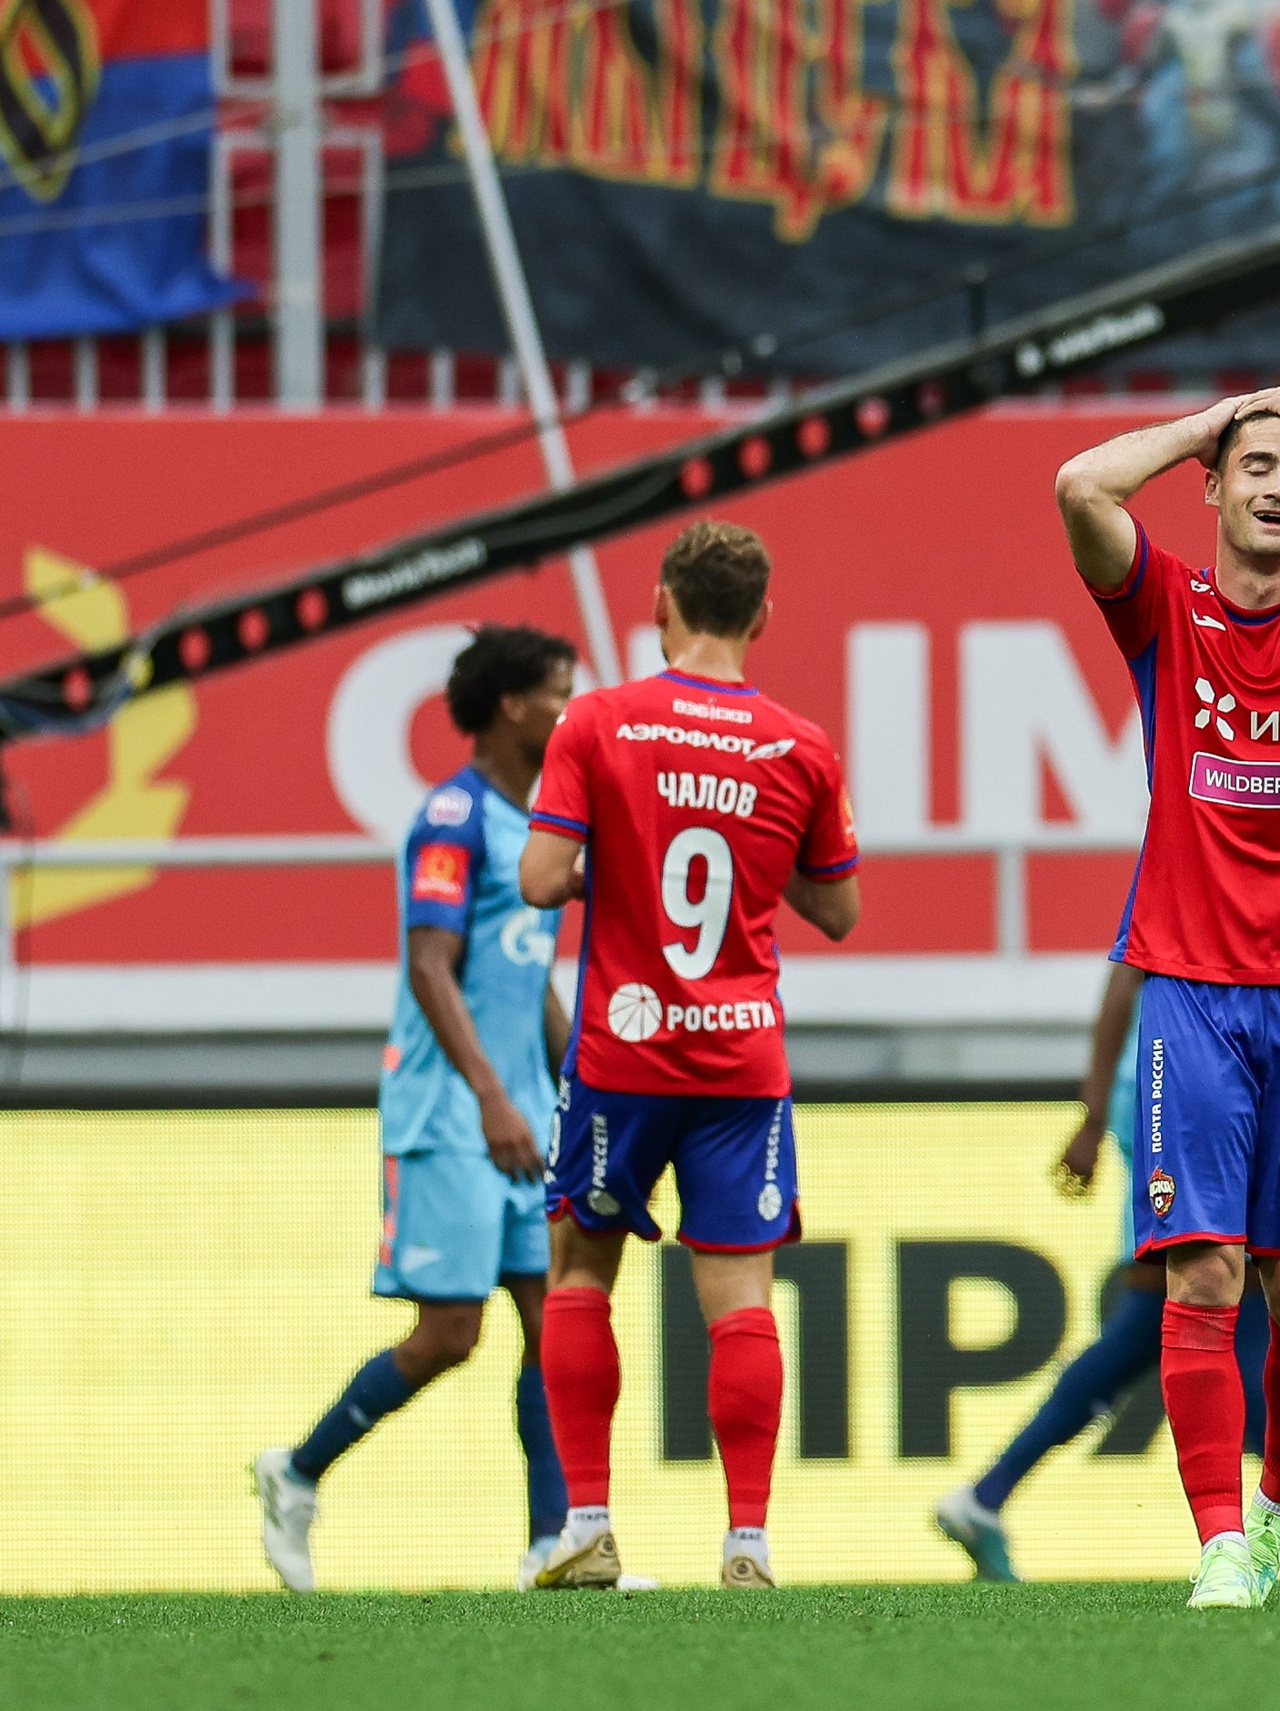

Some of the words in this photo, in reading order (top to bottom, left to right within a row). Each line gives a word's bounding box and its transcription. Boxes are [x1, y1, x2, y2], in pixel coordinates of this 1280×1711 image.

[617, 723, 757, 755] АЭРОФЛОТ
[657, 771, 758, 818] ЧАЛОВ
[660, 826, 735, 981] 9
[1151, 1038, 1164, 1100] РОССИИ
[1151, 1103, 1164, 1153] ПОЧТА
